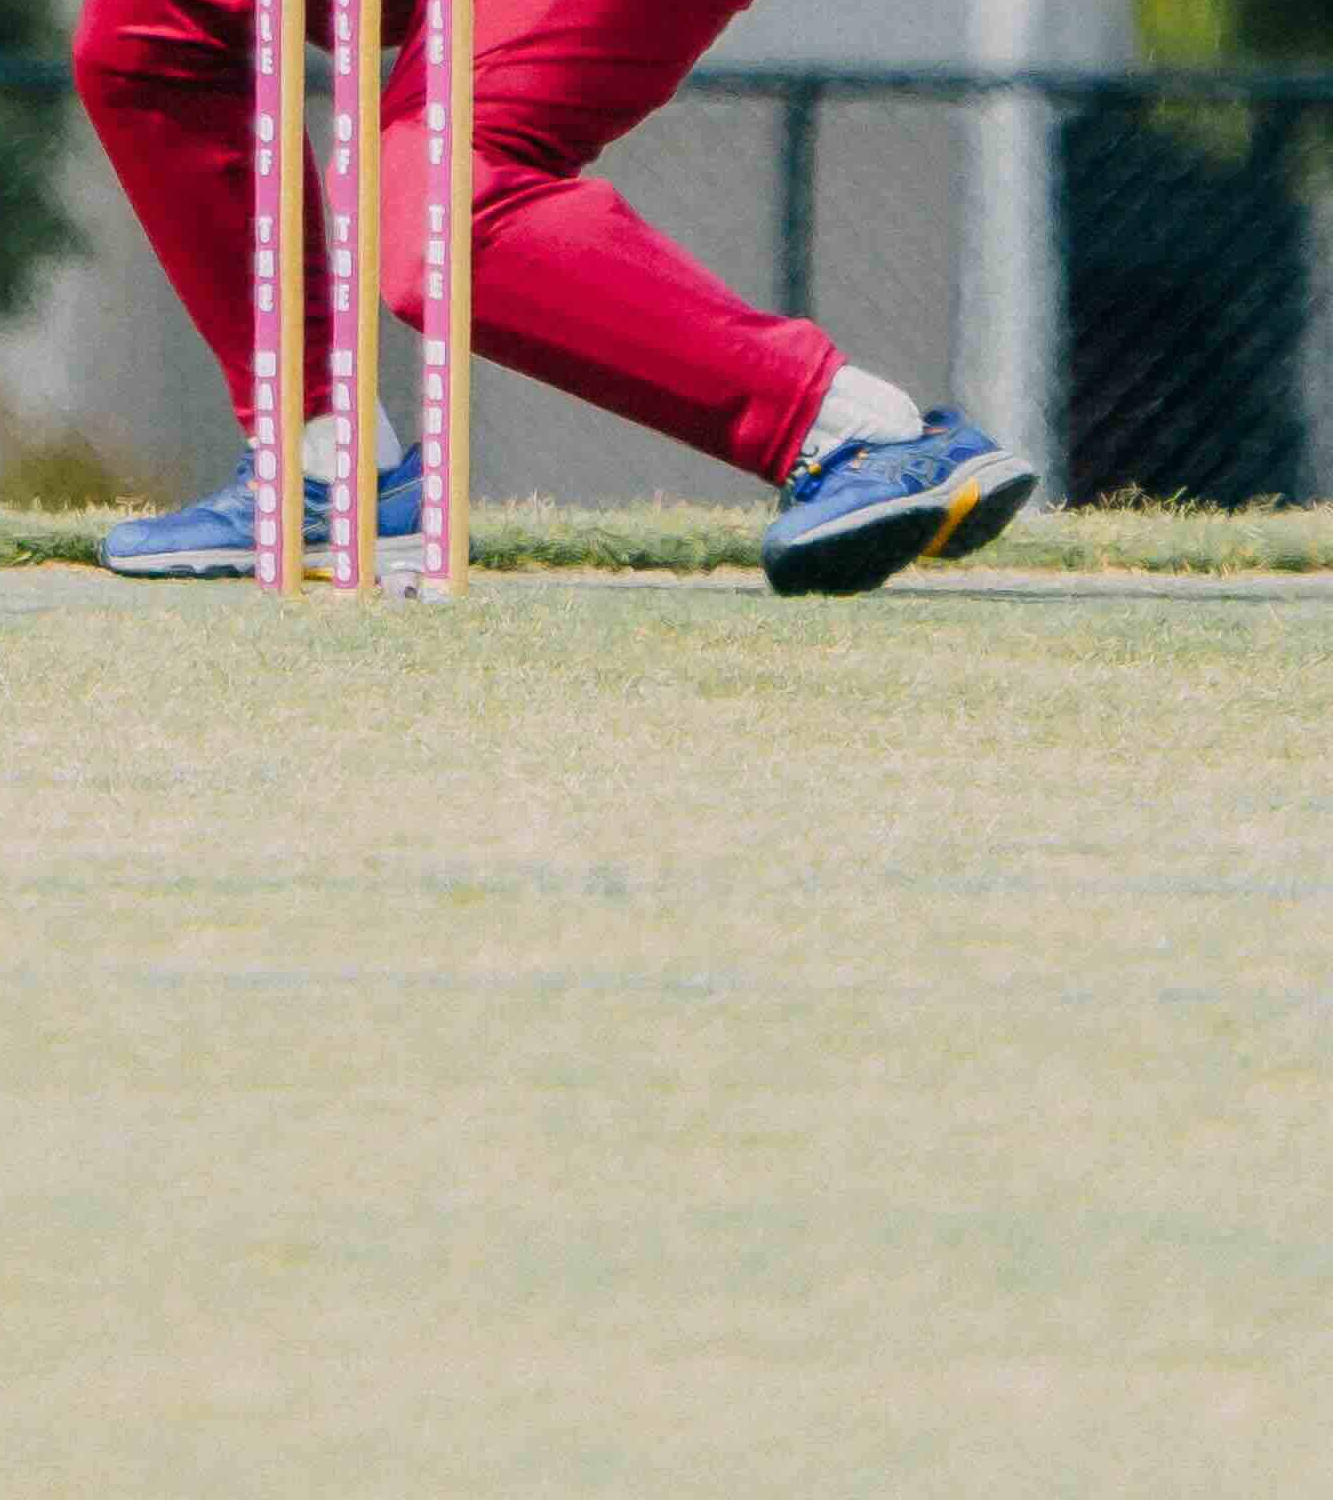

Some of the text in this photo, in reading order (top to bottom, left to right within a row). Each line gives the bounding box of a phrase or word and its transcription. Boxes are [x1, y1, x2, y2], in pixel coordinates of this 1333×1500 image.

[257, 112, 275, 176] OF
[336, 112, 353, 175] OF
[427, 101, 446, 165] OF
[257, 215, 275, 312] THE
[335, 215, 353, 312] THE
[427, 203, 446, 300] THE
